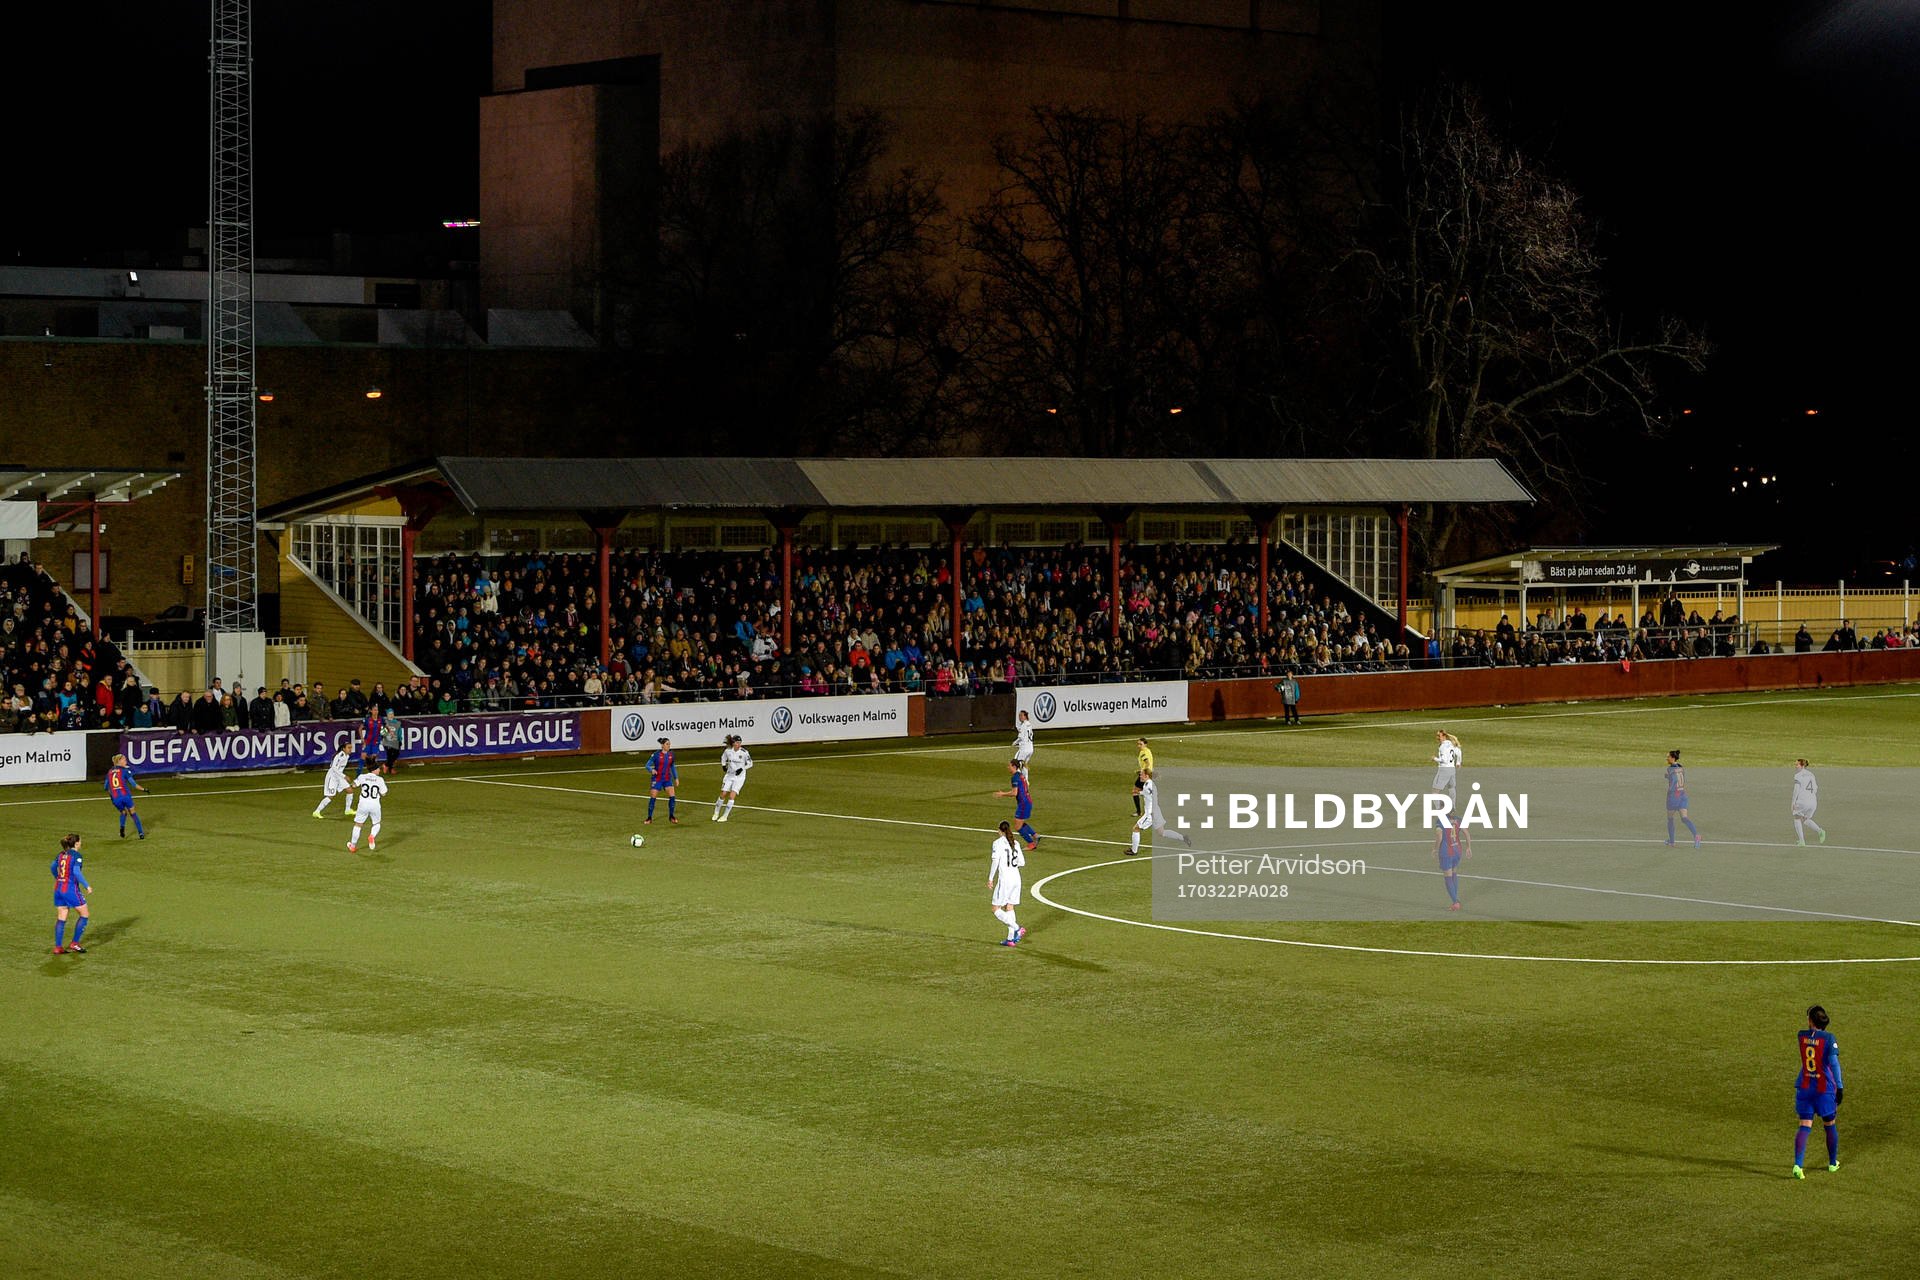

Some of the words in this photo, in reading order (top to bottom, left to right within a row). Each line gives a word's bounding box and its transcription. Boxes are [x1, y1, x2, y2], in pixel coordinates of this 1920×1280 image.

[1550, 566, 1566, 576] Bäst
[1567, 565, 1576, 578] på
[1577, 565, 1593, 577] plan
[1594, 565, 1615, 576] sedan
[1616, 565, 1626, 575] 20
[1627, 563, 1637, 575] år!
[1063, 697, 1129, 713] Volkswagen
[1132, 695, 1168, 710] Malmö
[651, 717, 716, 734] Volkswagen
[718, 715, 755, 730] Malmö
[799, 710, 861, 726] Volkswagen
[863, 708, 897, 723] Malmö
[127, 738, 200, 764] UEFA
[204, 732, 327, 759] WOMEN'S
[333, 723, 478, 753] CHPIONS
[485, 719, 574, 746] LEAGUE
[26, 749, 71, 763] Malmö
[111, 773, 119, 787] 6
[1805, 780, 1814, 793] 4
[361, 783, 380, 800] 30
[59, 859, 67, 878] 3
[1805, 1046, 1817, 1072] 8
